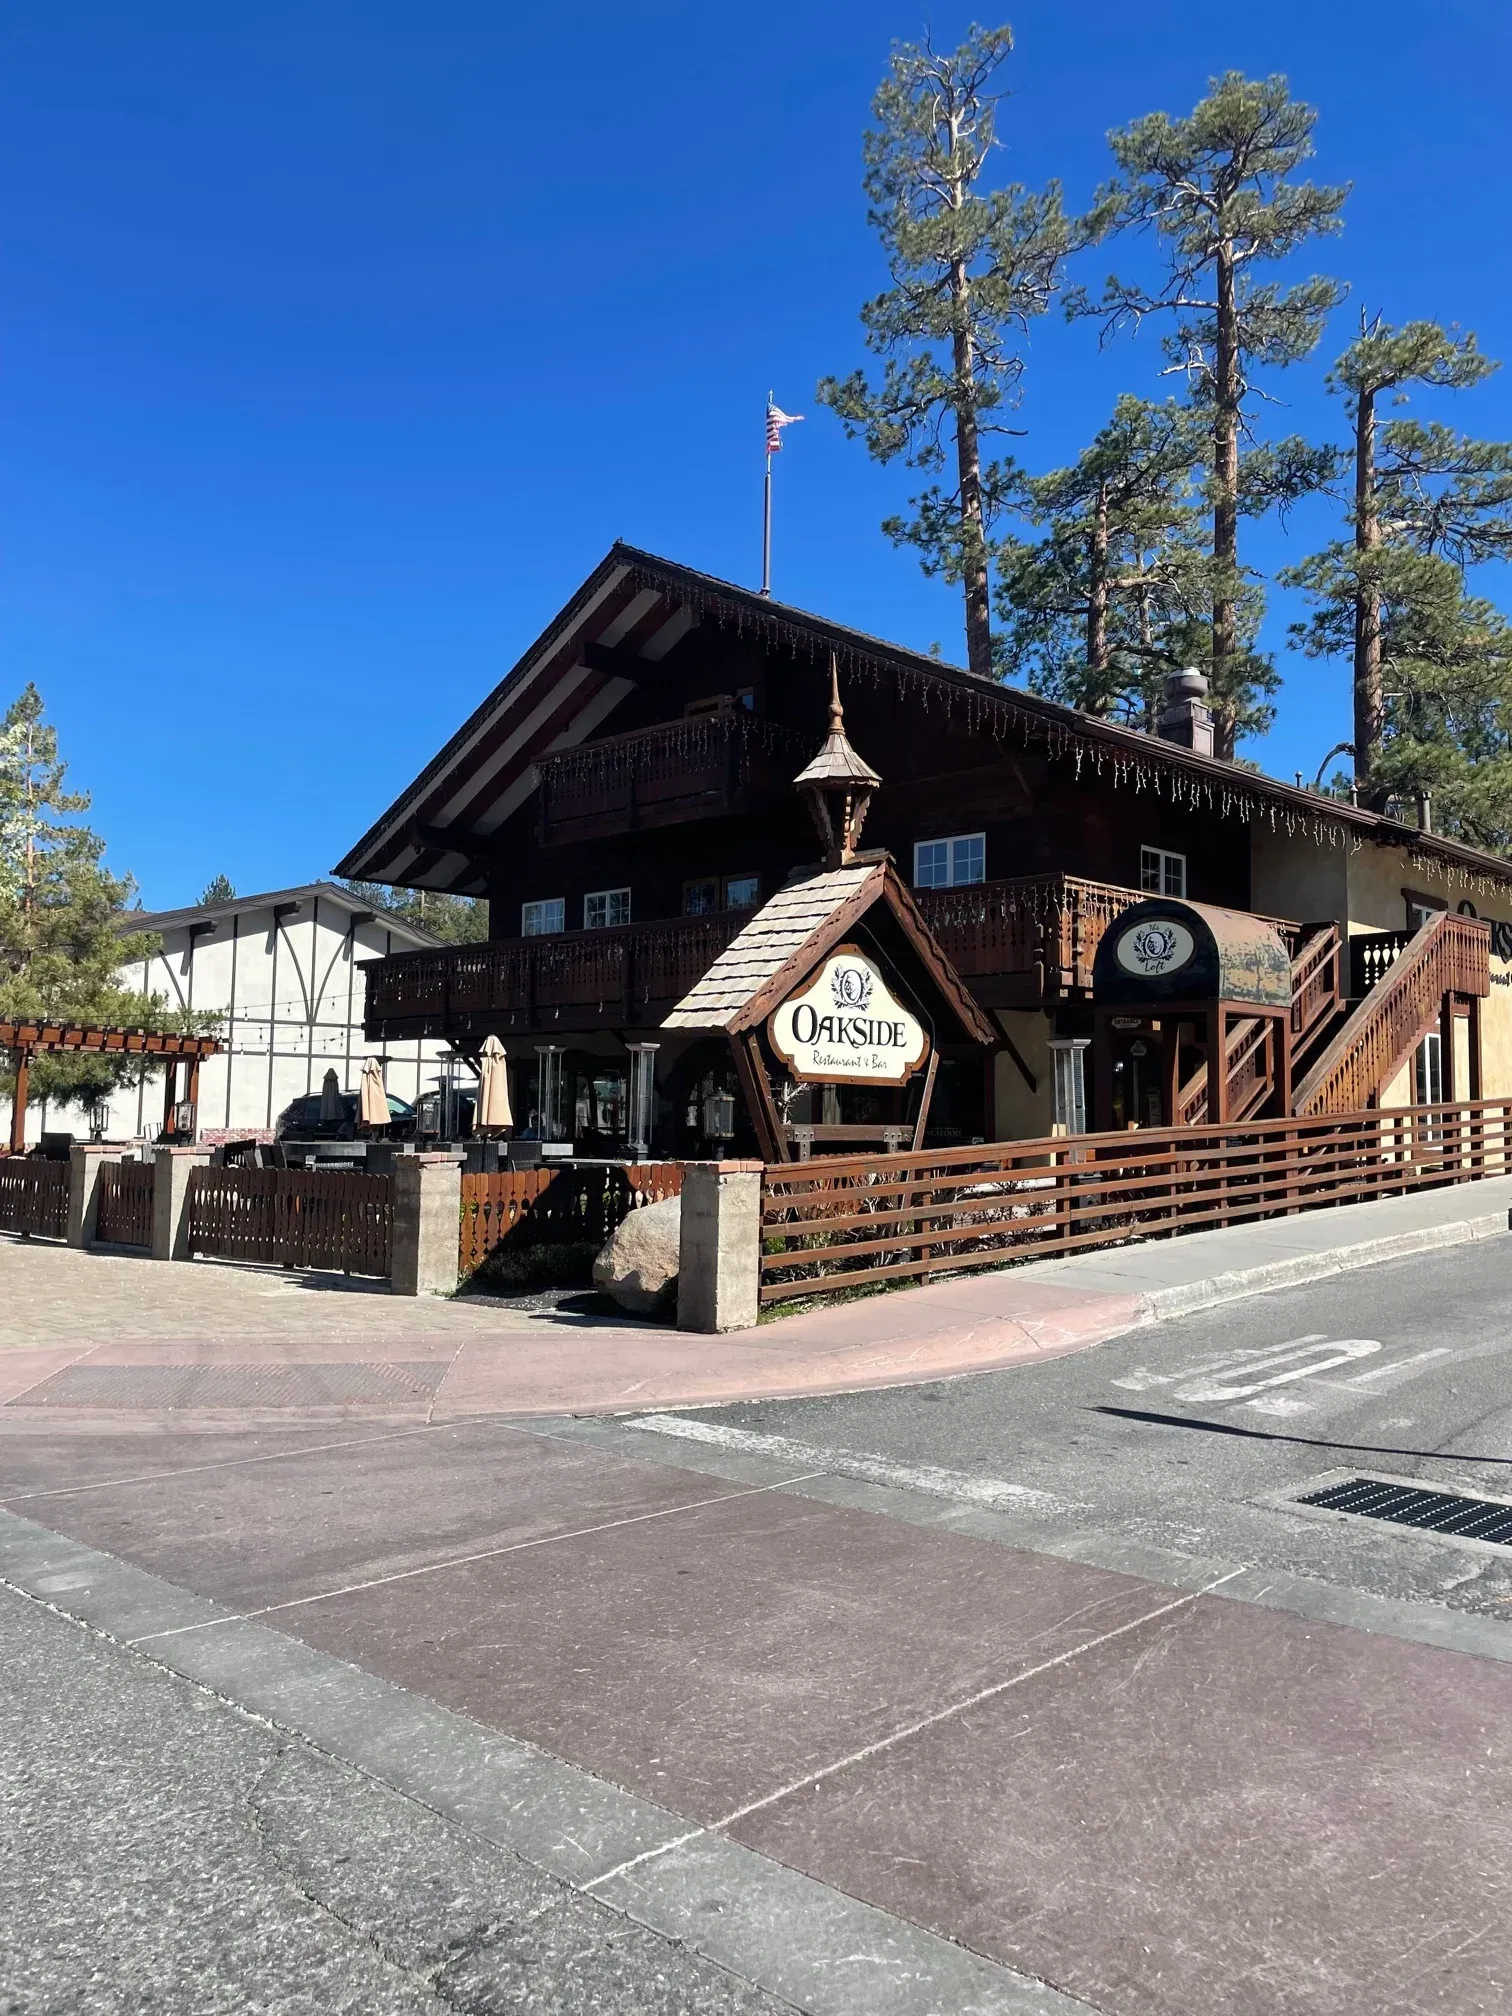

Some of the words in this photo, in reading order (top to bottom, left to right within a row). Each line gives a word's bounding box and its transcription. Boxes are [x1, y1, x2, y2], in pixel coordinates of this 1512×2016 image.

[1148, 923, 1160, 932] The
[1145, 960, 1166, 973] Loft
[792, 1004, 907, 1049] OAKSIDE
[812, 1050, 862, 1067] Restaurant
[871, 1053, 888, 1069] Bar
[926, 1129, 962, 1137] SEAFOOD
